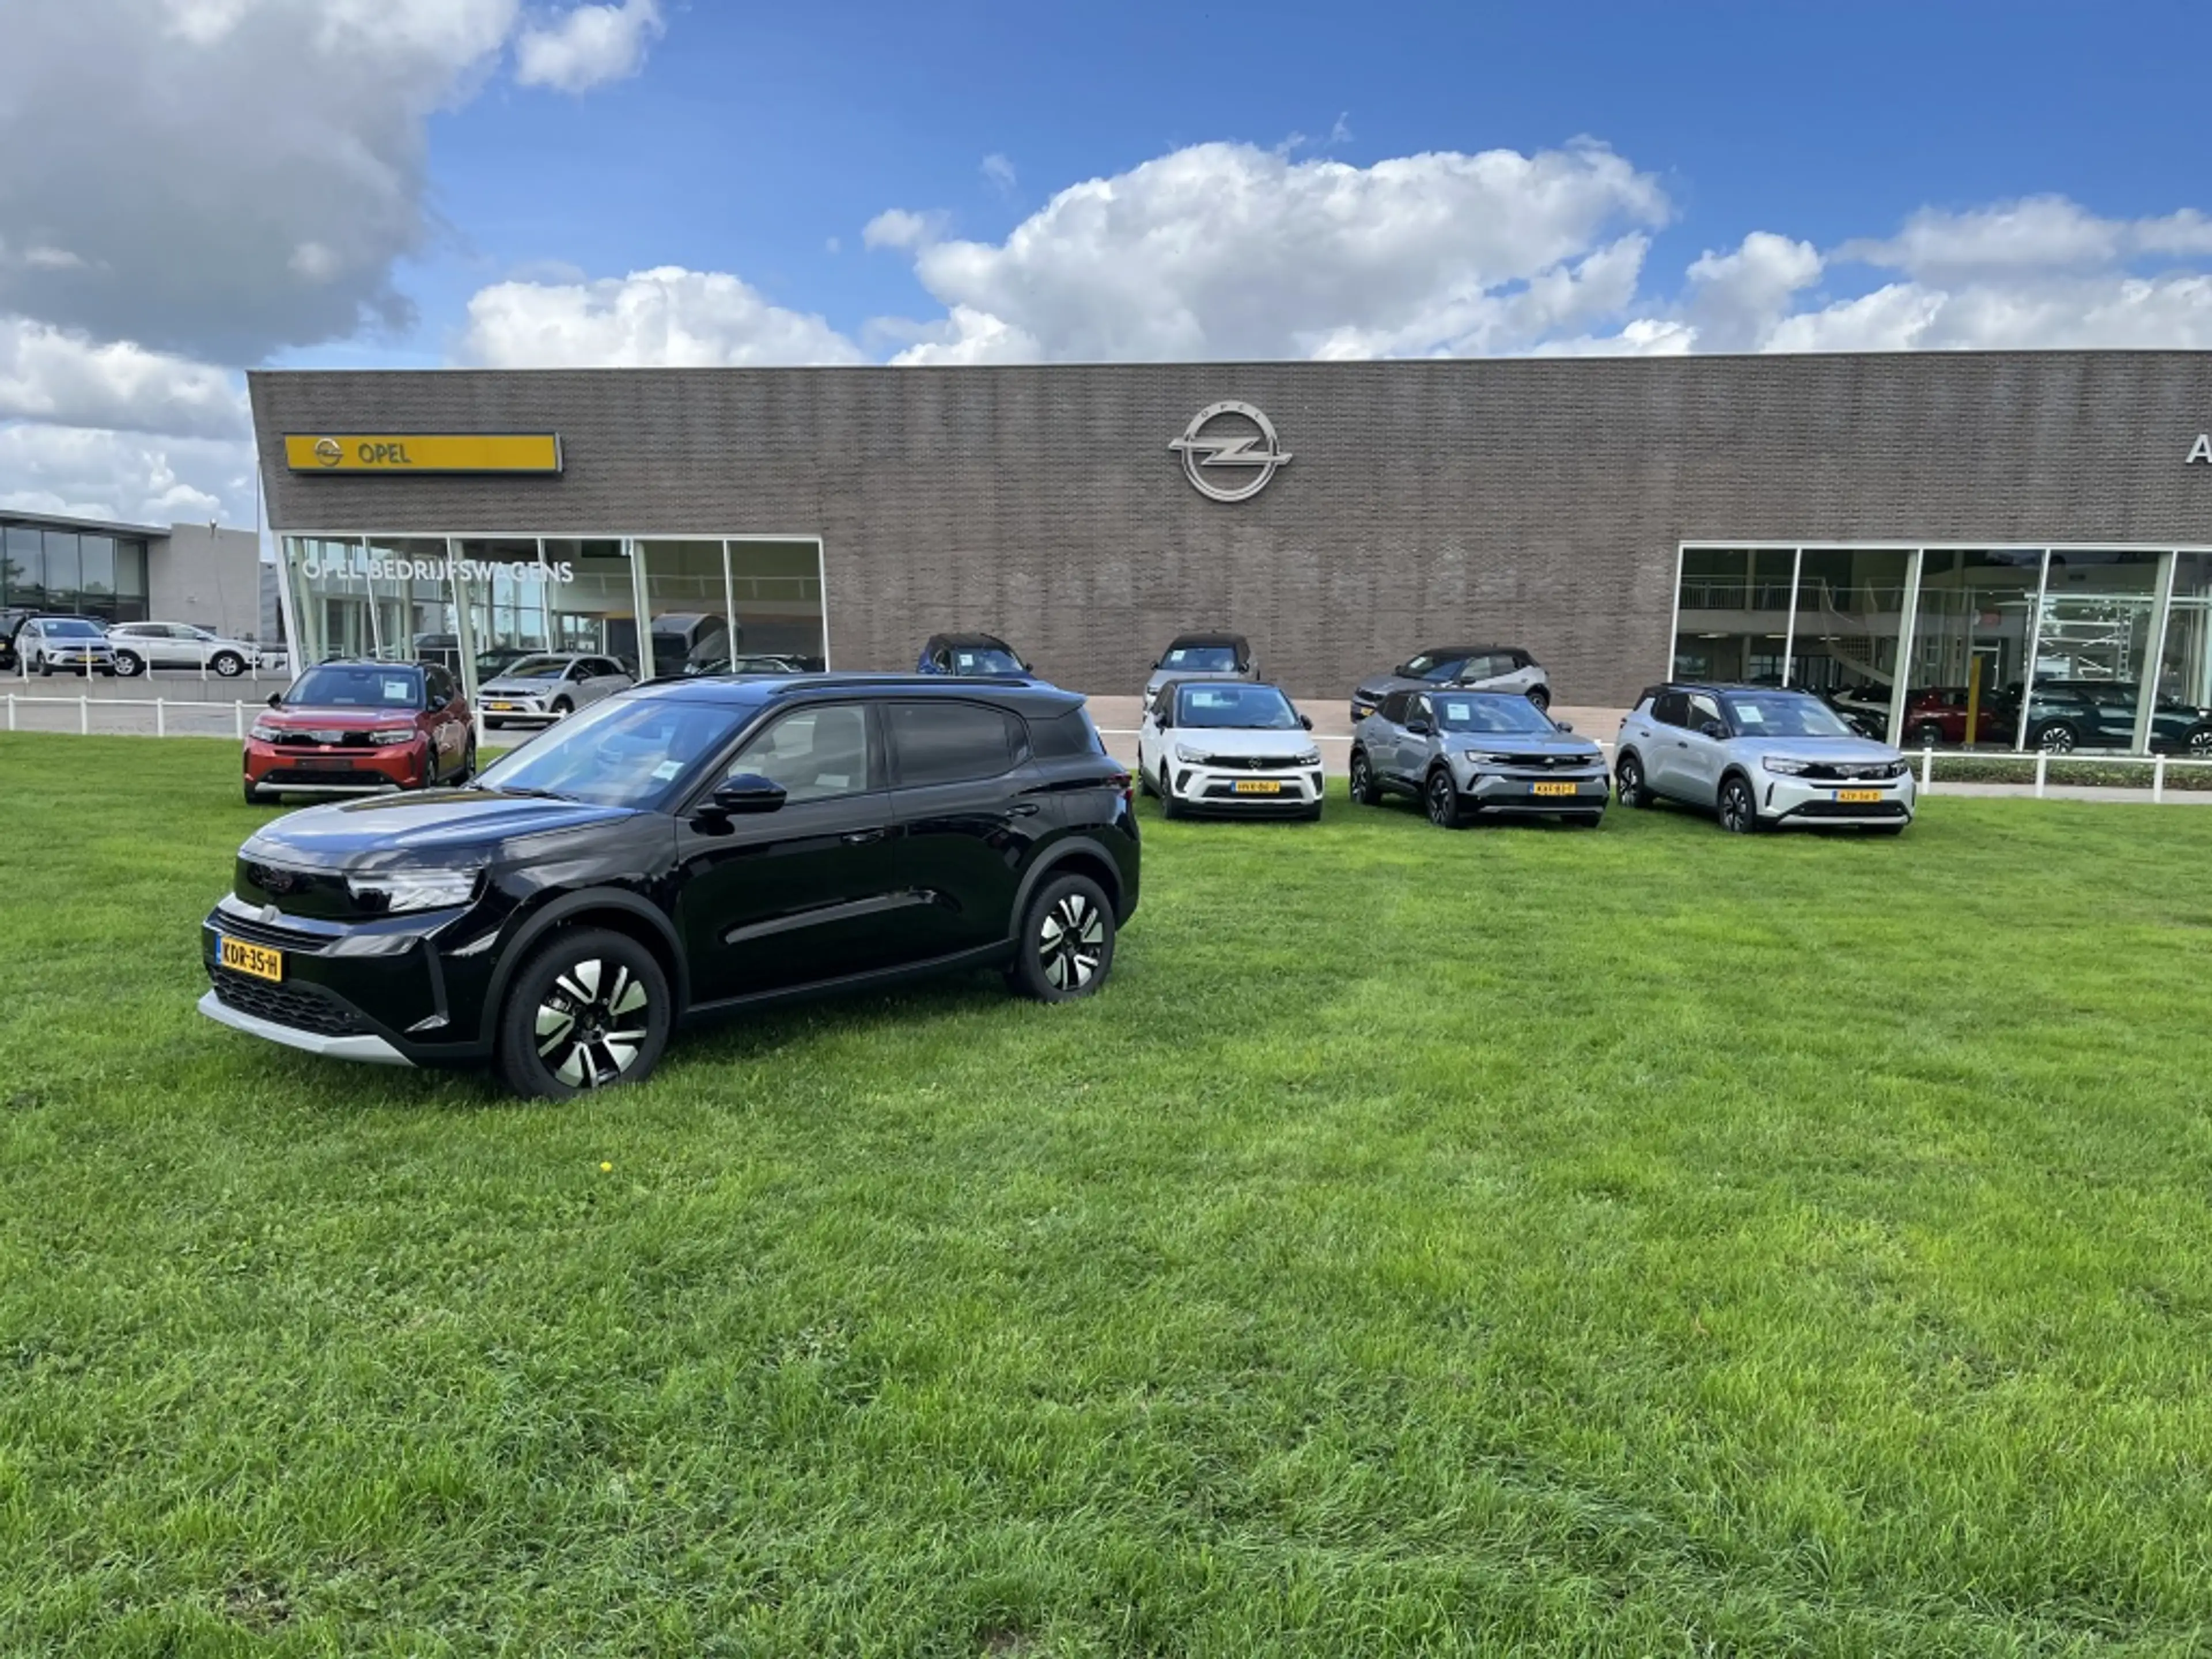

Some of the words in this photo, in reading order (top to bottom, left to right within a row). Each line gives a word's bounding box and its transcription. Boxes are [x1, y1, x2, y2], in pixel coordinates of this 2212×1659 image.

[358, 442, 412, 464] OPEL
[302, 559, 364, 579] OPEL
[368, 559, 574, 582] BEDRIJFSWAGENS
[222, 941, 278, 976] KDR-35-H
